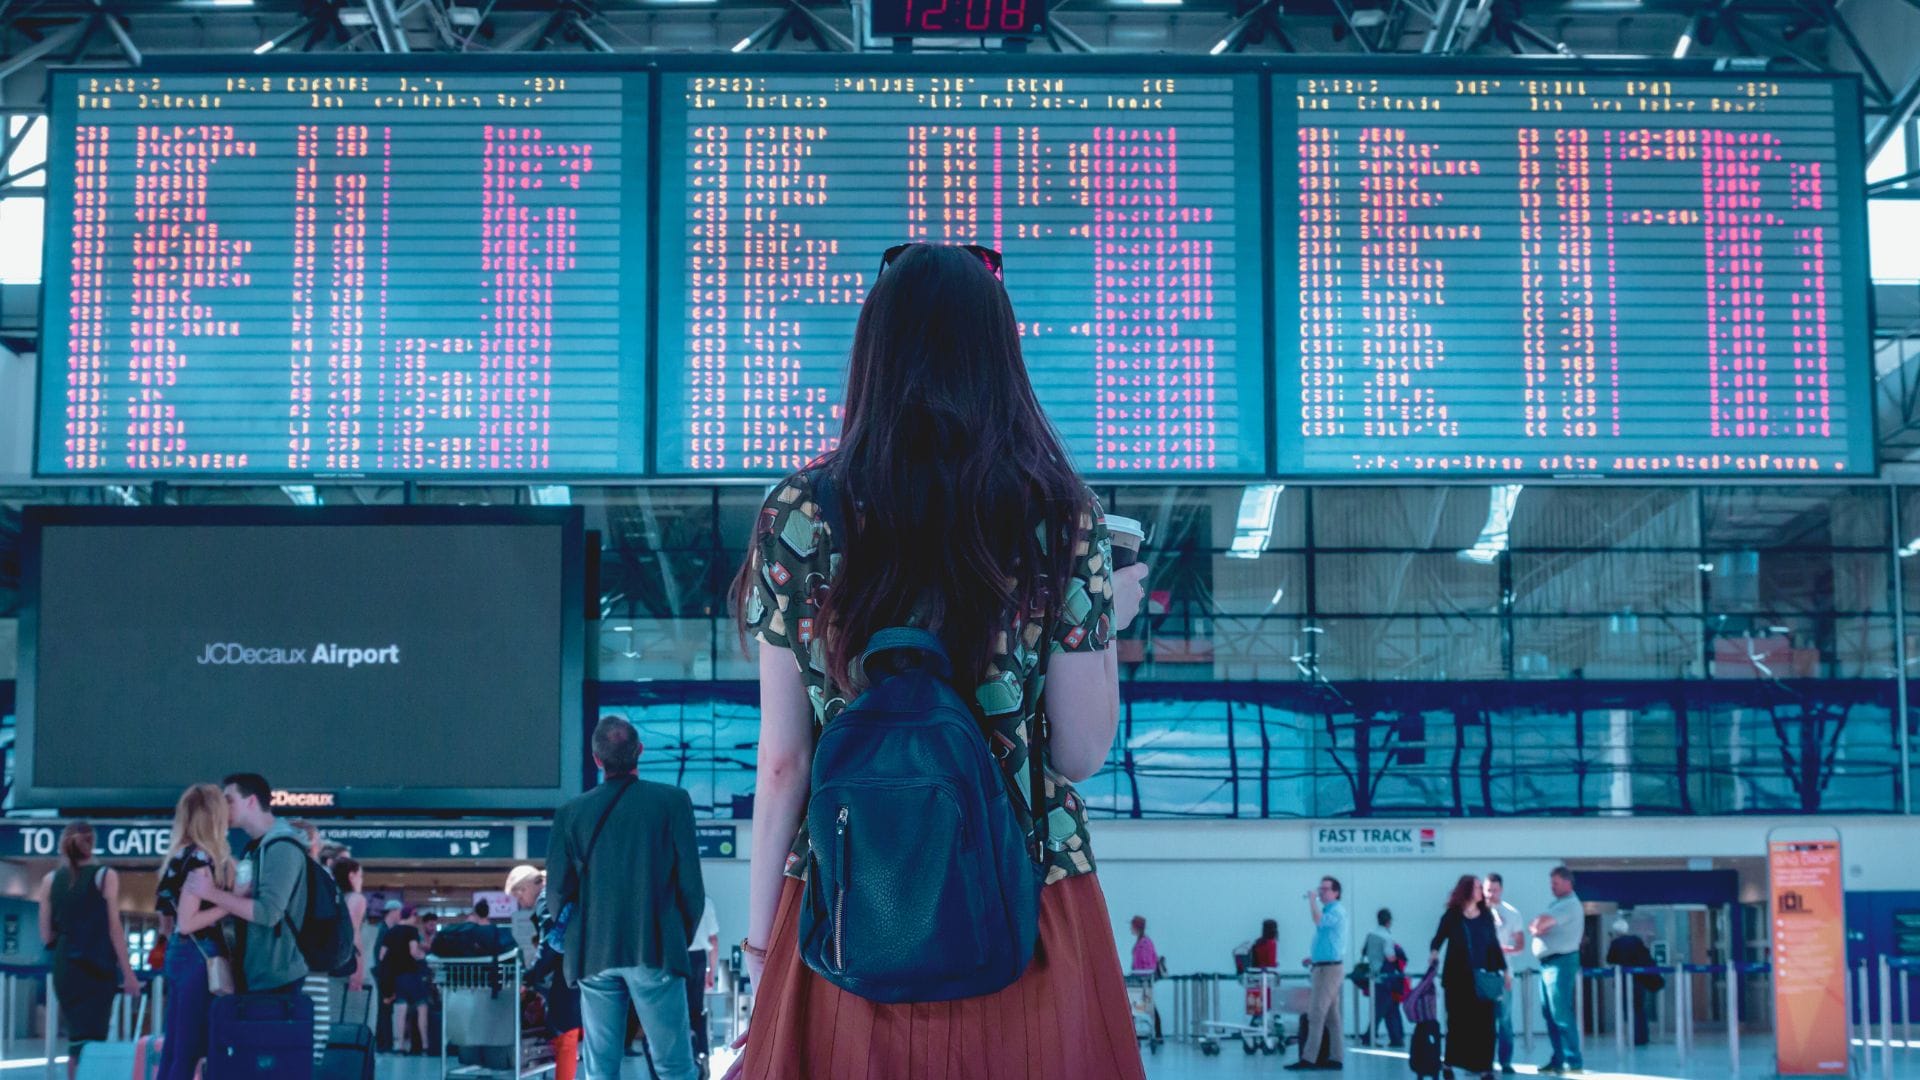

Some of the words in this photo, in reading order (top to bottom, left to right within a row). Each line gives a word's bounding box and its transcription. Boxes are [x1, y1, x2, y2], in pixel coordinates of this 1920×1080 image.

[904, 0, 1026, 30] 12:08
[196, 643, 306, 665] JCDecaux
[311, 643, 399, 668] Airport
[270, 790, 334, 807] CDecaux
[18, 828, 54, 855] TO
[107, 828, 171, 855] GATE
[328, 829, 348, 839] YOUR
[349, 829, 386, 839] PASSPORT
[388, 829, 404, 839] AND
[406, 829, 443, 839] BOARDING
[444, 829, 463, 839] PASS
[464, 829, 490, 839] READY
[1319, 829, 1356, 842] FAST
[1362, 829, 1412, 842] TRACK
